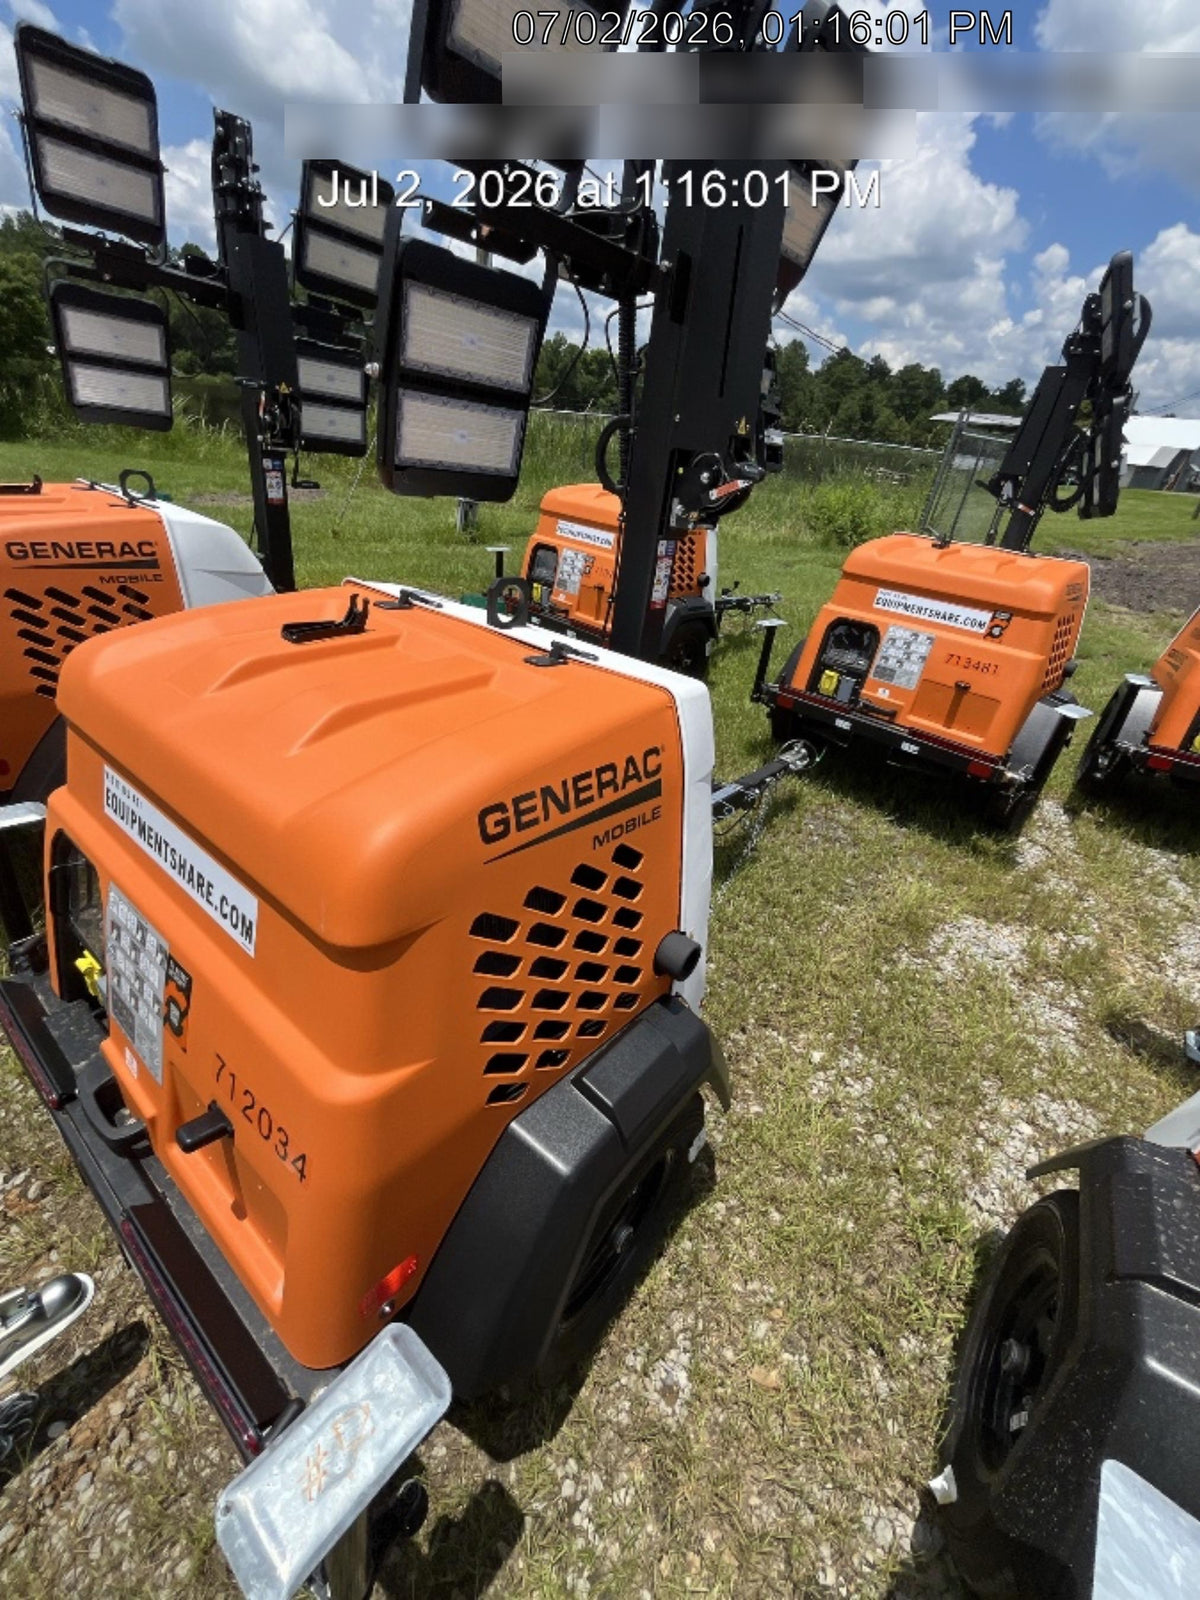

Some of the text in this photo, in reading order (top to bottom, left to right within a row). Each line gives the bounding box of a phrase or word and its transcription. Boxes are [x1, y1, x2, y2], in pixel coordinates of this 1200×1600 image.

[6, 541, 157, 561] GENERAC
[99, 573, 163, 584] MOBILE
[875, 596, 987, 631] EQUIPMENTSHARE.COM
[477, 746, 662, 845] GENERAC
[592, 805, 662, 850] MOBILE
[105, 788, 254, 945] EQUIPMENTSHARE.COM
[213, 1053, 308, 1182] 712034
